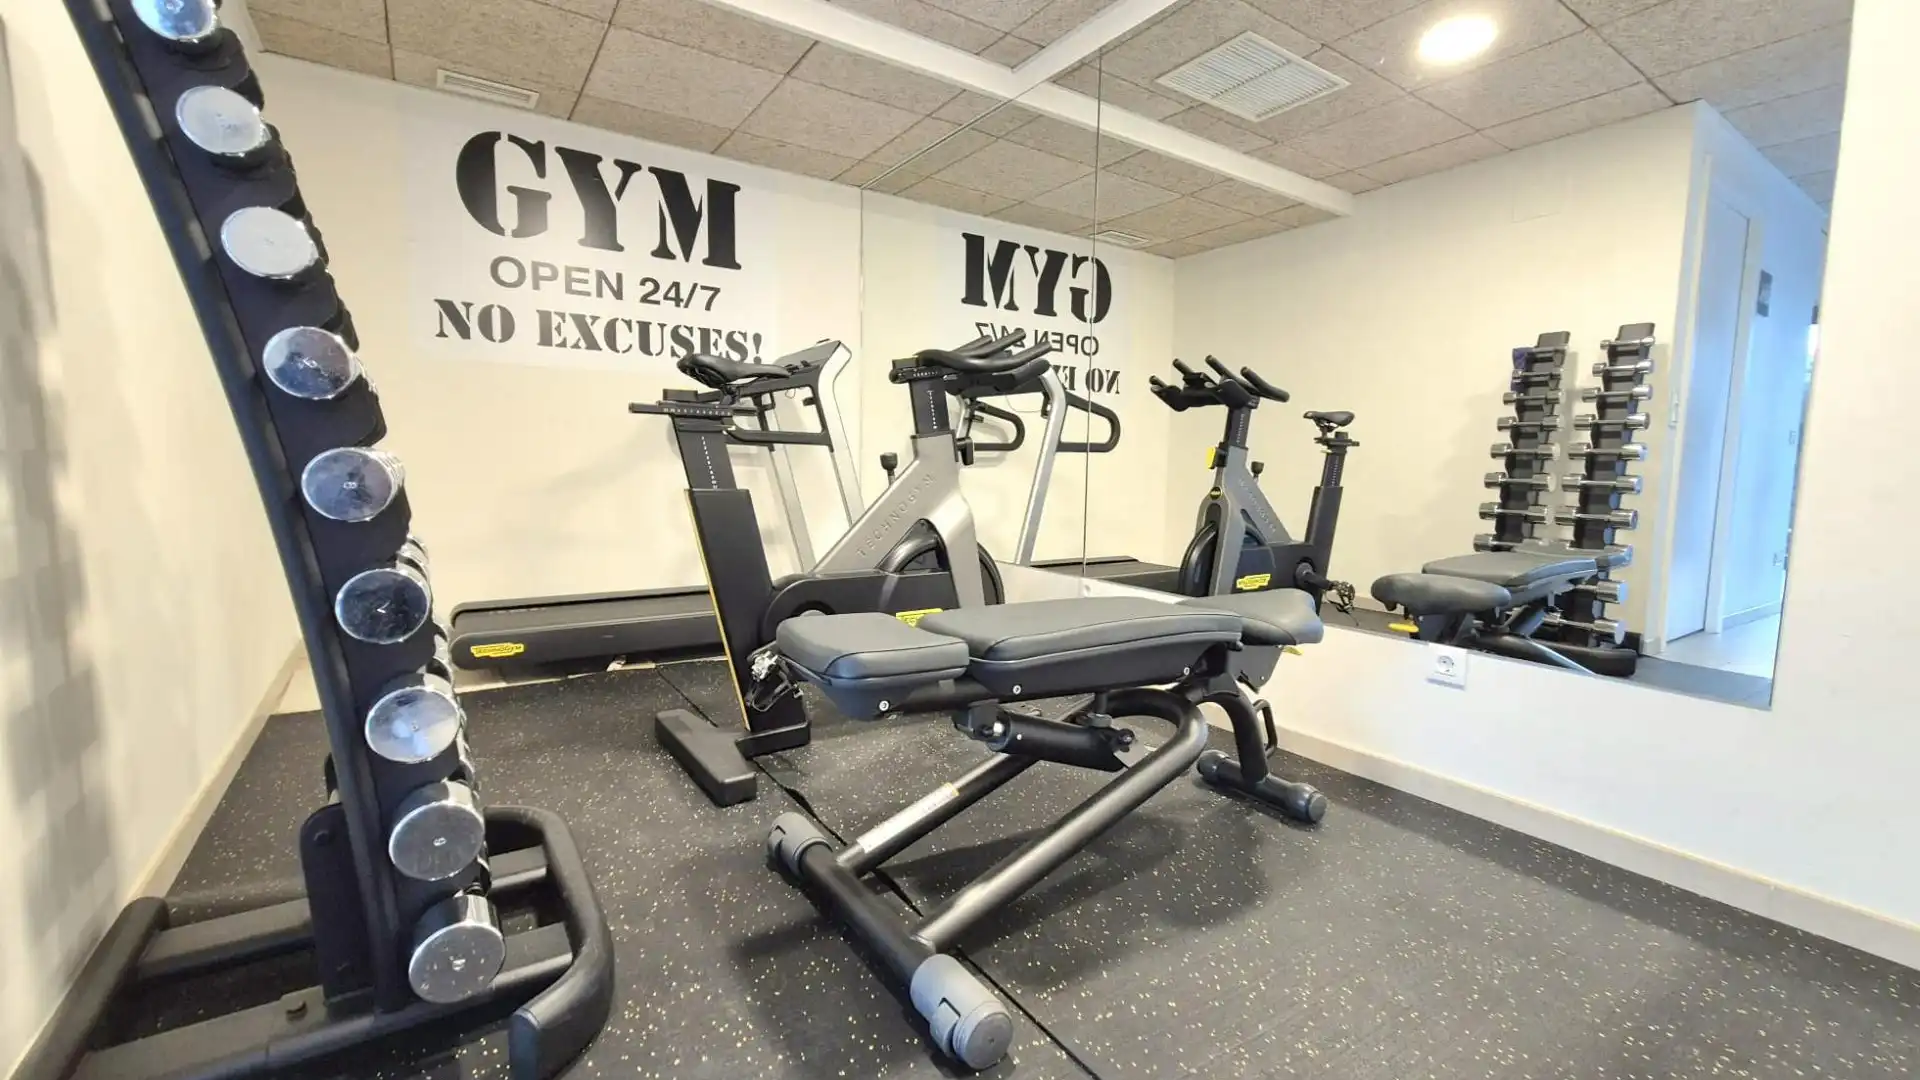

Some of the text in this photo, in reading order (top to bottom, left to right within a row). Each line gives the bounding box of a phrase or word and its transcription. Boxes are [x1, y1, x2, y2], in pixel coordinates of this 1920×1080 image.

[456, 131, 742, 270] GYM
[490, 255, 721, 311] OPEN 24/7
[434, 298, 763, 364] NO EXCUSES!
